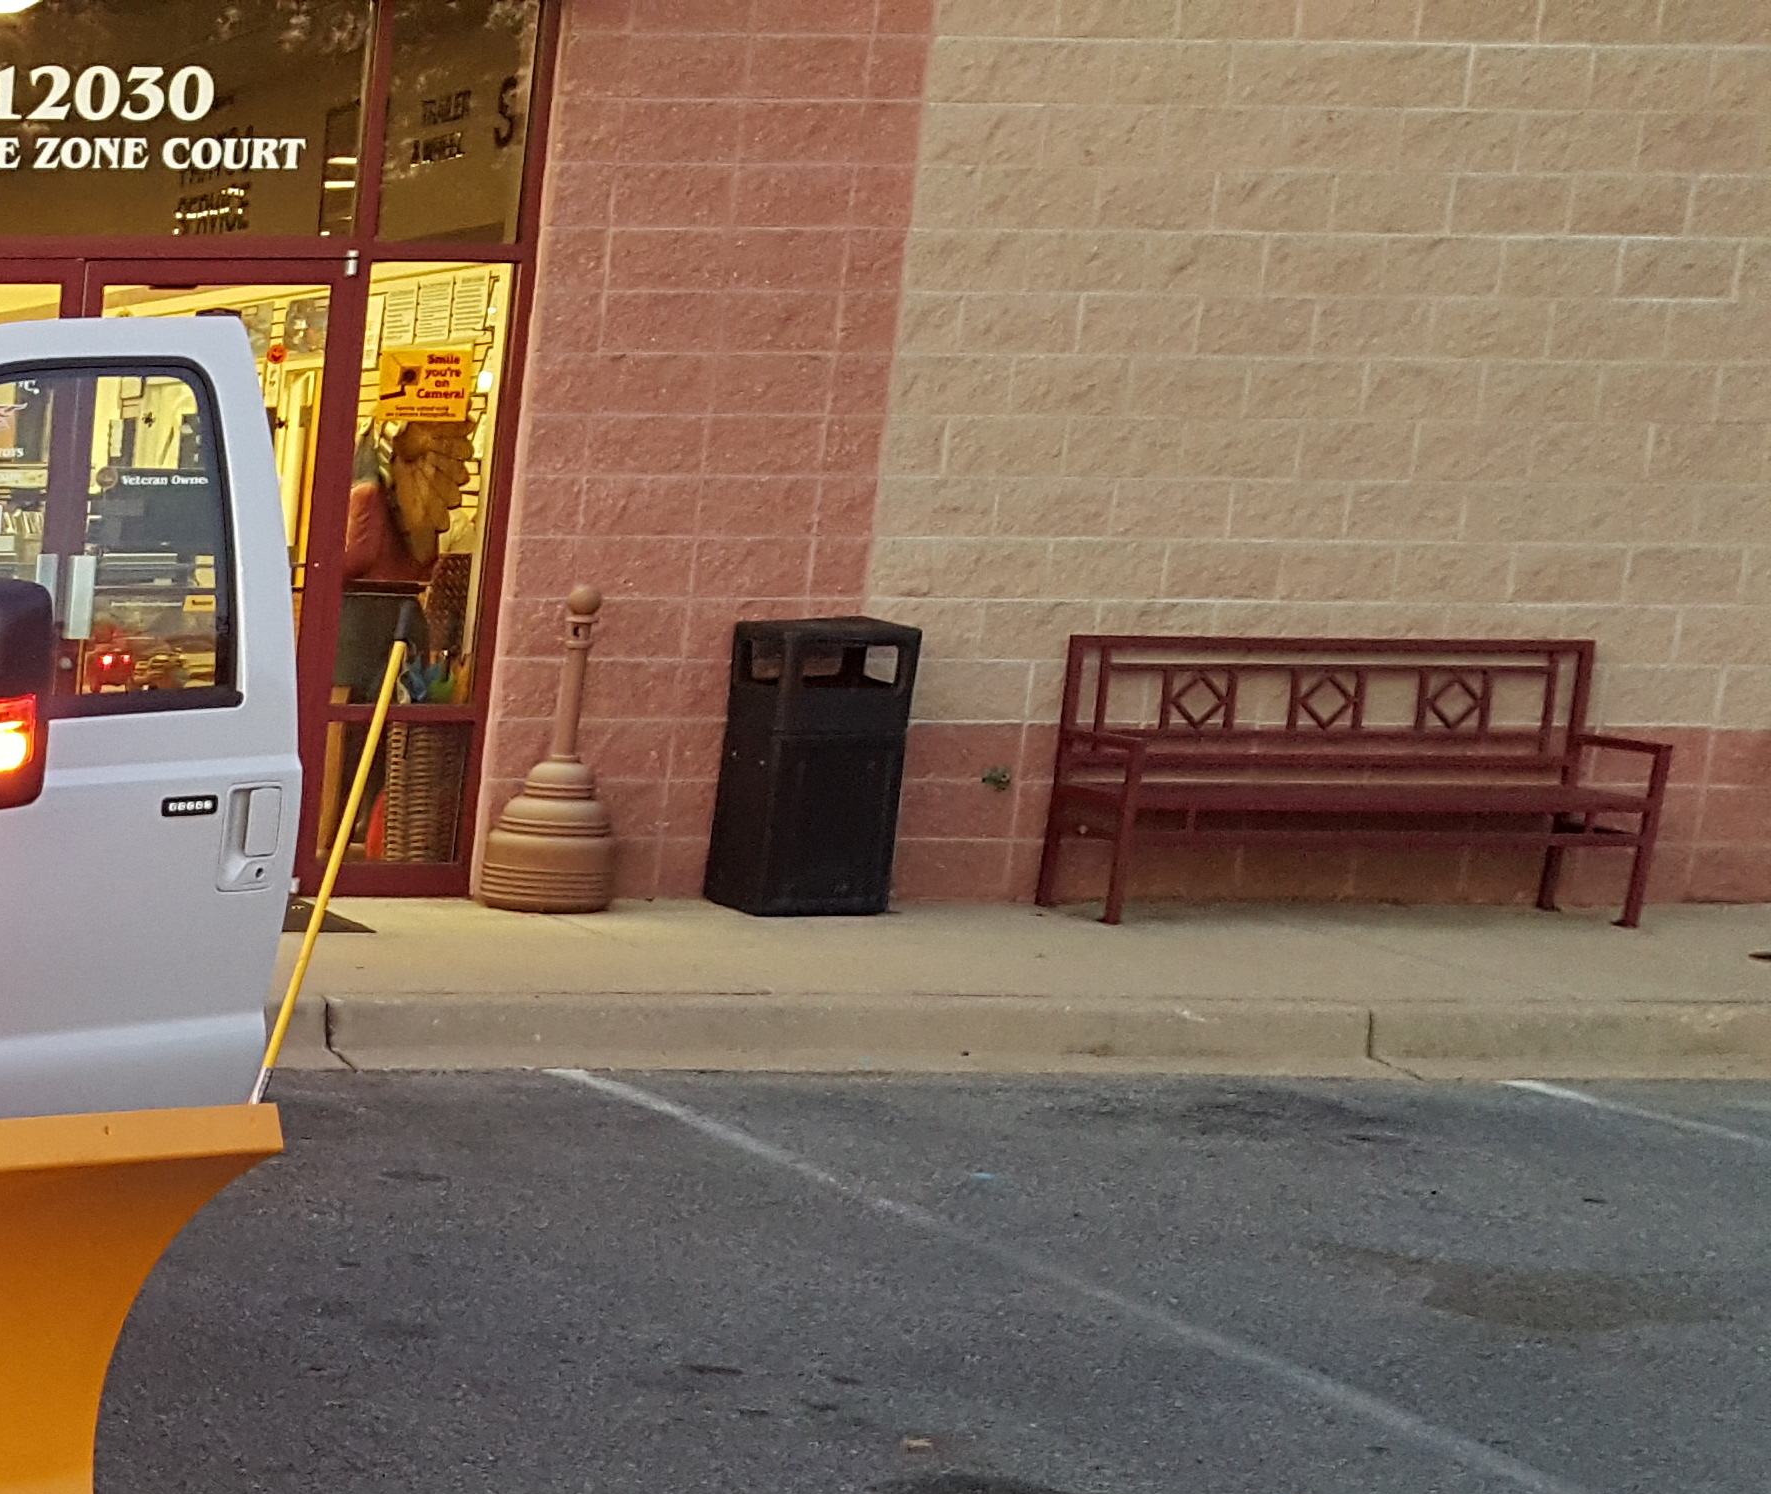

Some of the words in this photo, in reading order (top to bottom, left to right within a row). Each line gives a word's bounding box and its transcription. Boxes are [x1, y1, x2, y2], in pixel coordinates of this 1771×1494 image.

[33, 137, 151, 170] ZONE
[162, 137, 307, 170] COURT
[427, 354, 461, 365] Smile
[424, 367, 462, 379] you're
[416, 388, 465, 399] Camera!
[121, 474, 168, 486] Veteran
